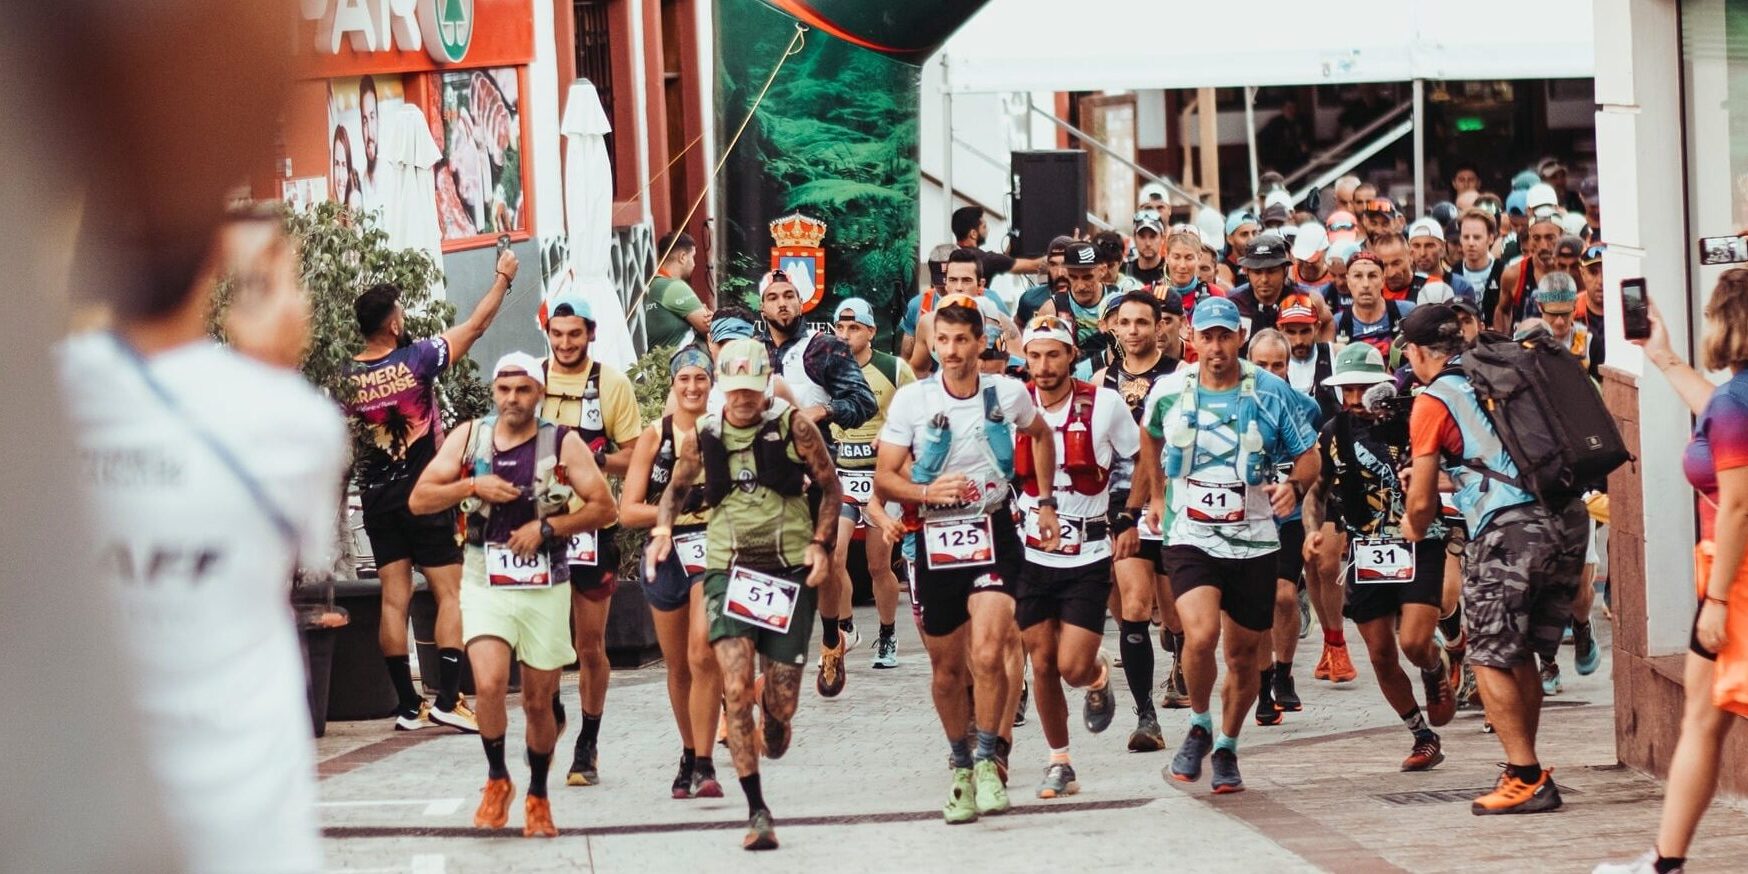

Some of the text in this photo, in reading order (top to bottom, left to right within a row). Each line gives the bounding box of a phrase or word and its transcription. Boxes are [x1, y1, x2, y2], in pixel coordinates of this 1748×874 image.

[350, 361, 412, 388] OMERA
[352, 373, 418, 405] ARADISE
[849, 480, 871, 493] 20
[1200, 492, 1227, 508] 41
[937, 528, 980, 548] 125
[1060, 524, 1073, 540] 2
[500, 552, 539, 569] 108
[691, 544, 706, 560] 3
[1371, 548, 1396, 565] 31
[747, 586, 775, 606] 51
